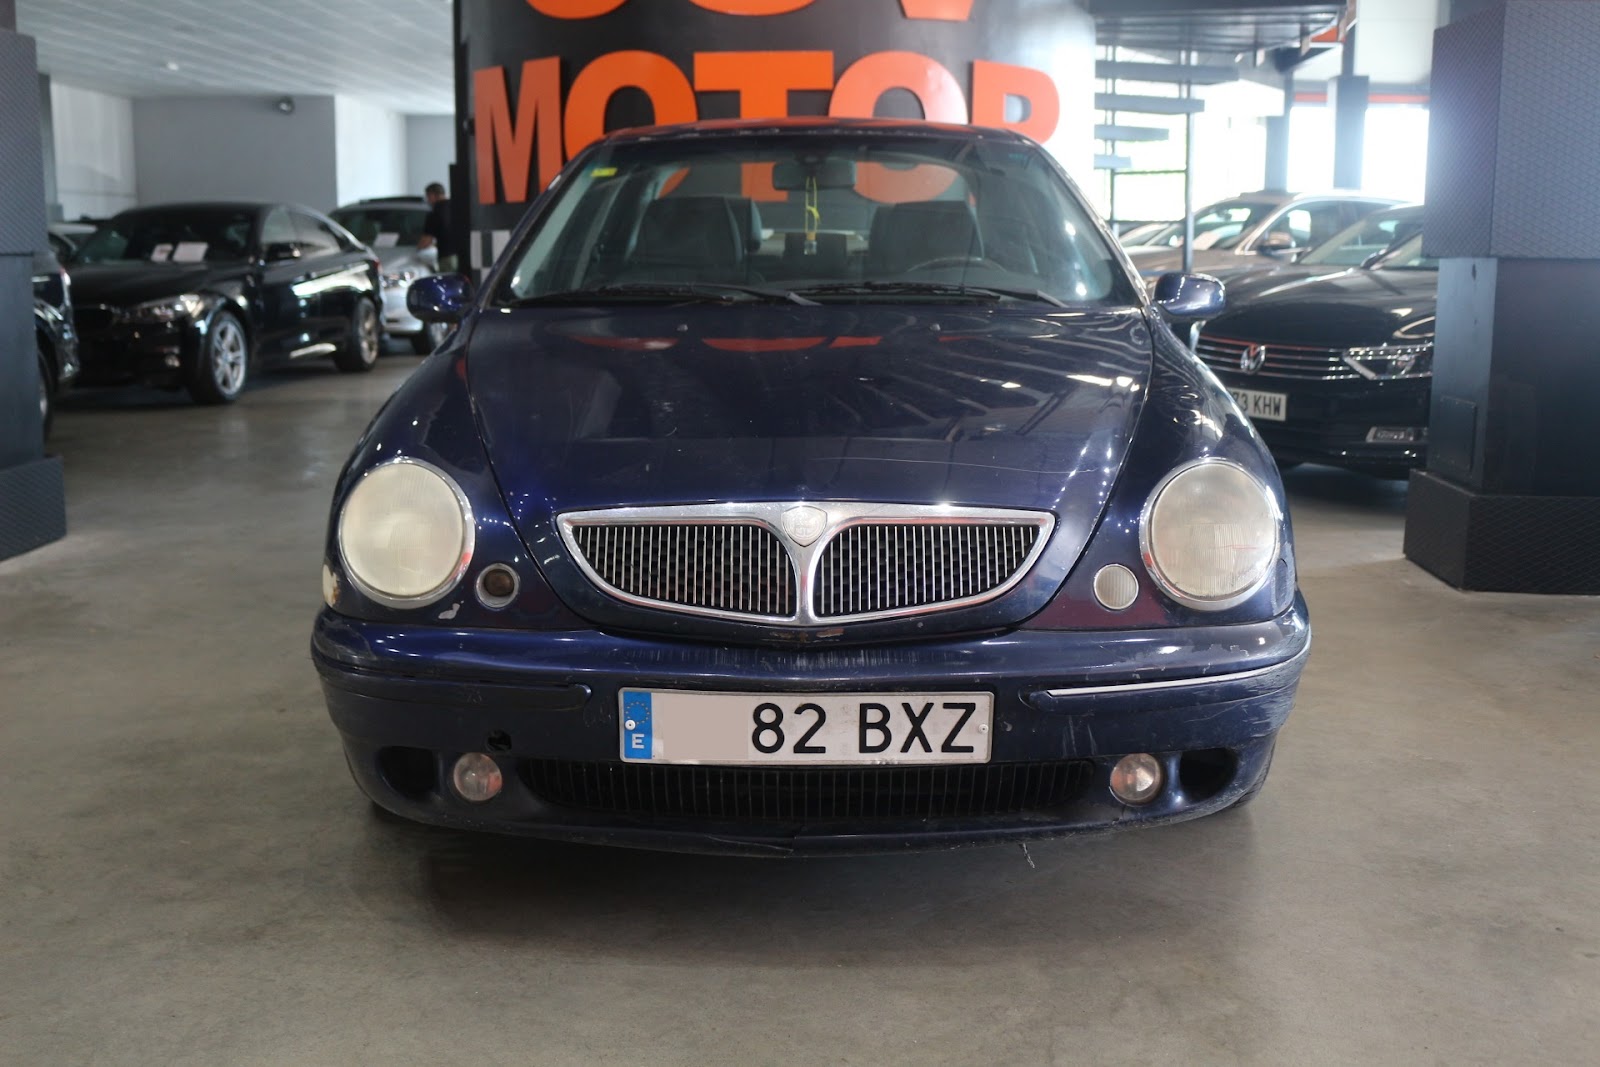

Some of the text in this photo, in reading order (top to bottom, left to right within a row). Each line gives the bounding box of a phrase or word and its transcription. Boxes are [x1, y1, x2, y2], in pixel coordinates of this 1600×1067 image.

[1253, 394, 1282, 417] KHW
[858, 702, 977, 754] BXZ
[631, 733, 646, 750] E
